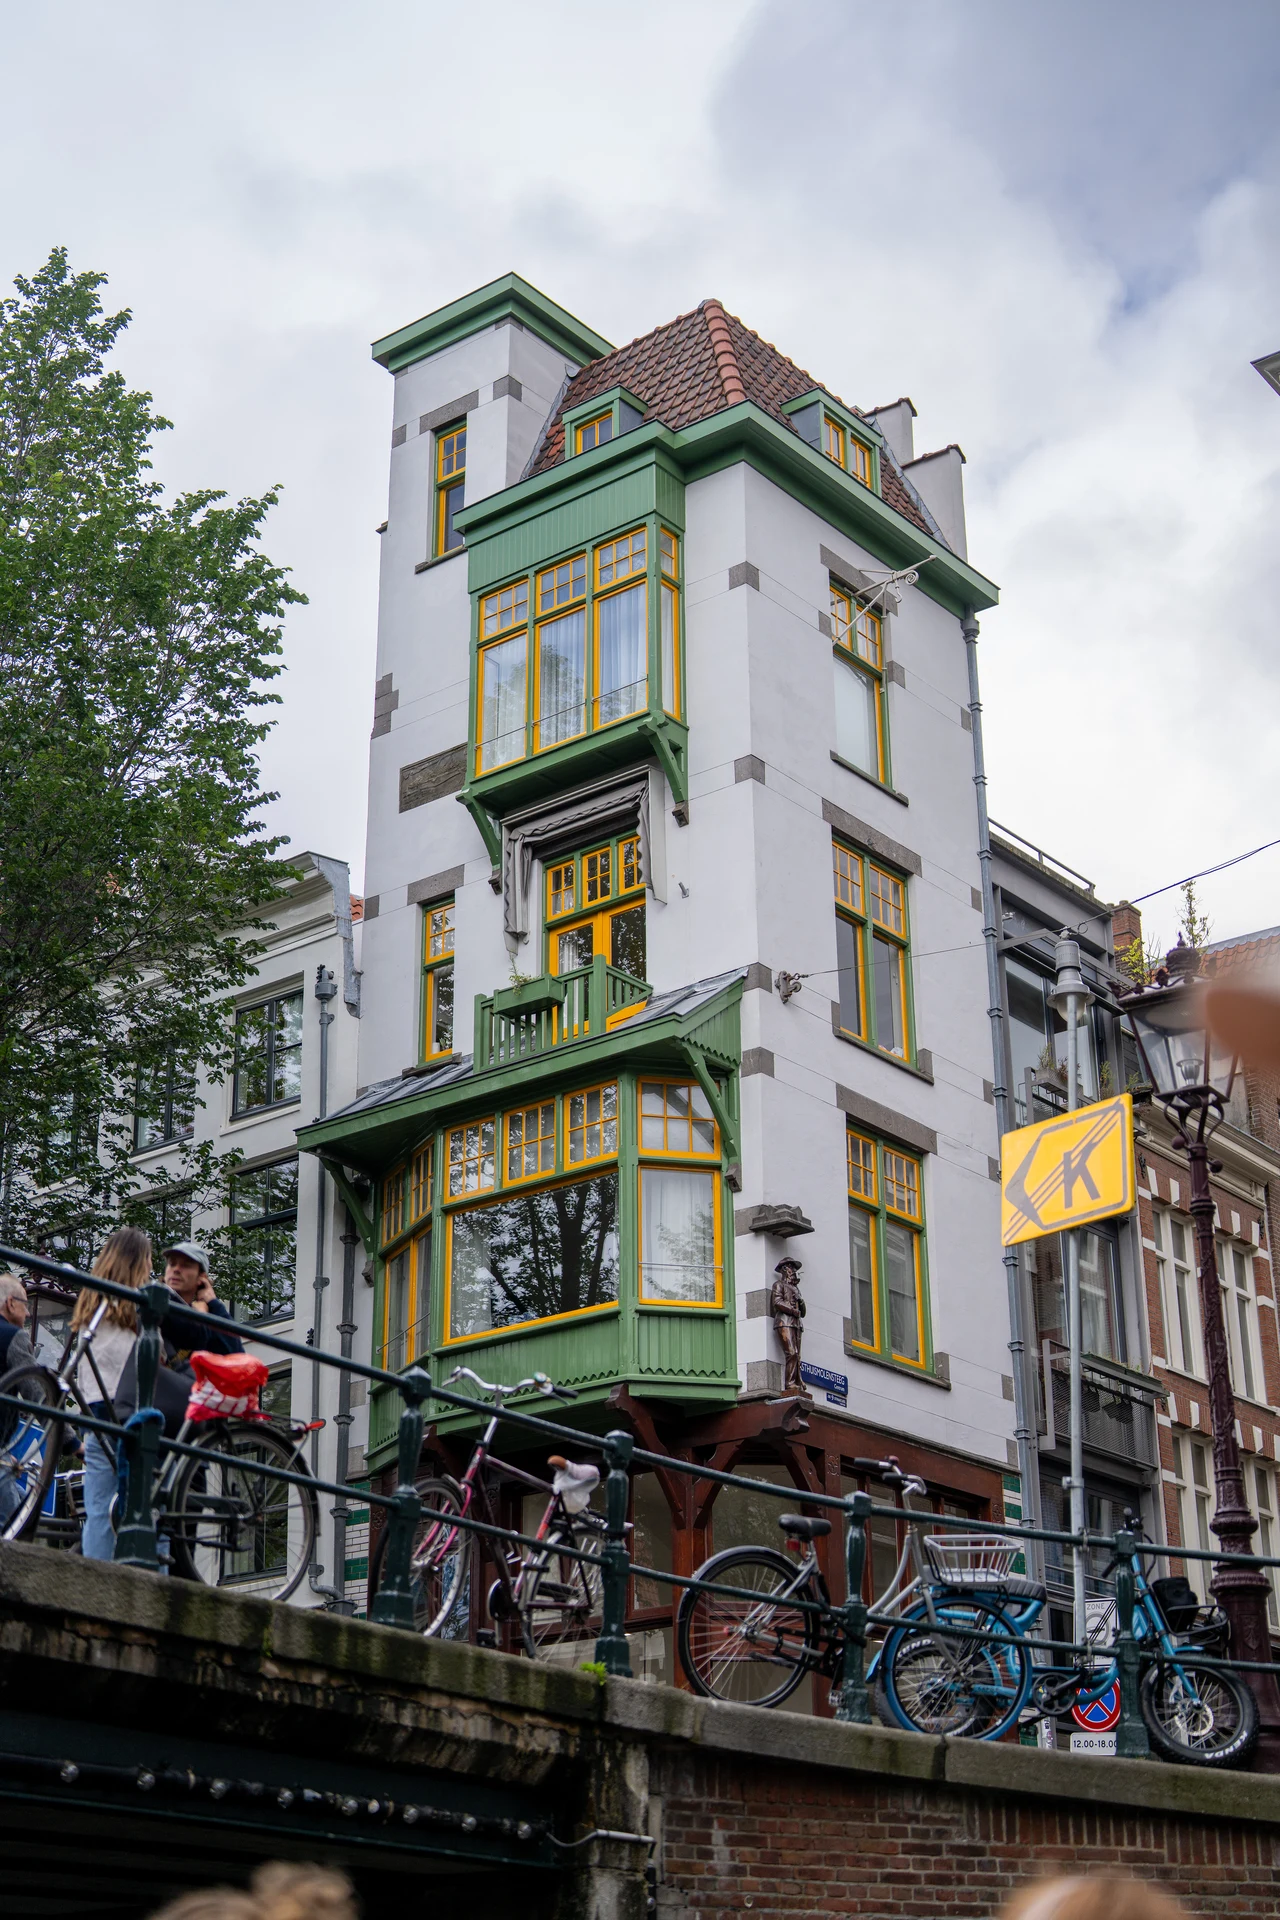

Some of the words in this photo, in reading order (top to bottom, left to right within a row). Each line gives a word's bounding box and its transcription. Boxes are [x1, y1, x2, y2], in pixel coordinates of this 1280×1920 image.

[800, 1362, 845, 1385] STHUISMOLENSTEEG
[896, 1638, 935, 1661] KEND
[1073, 1739, 1117, 1749] 12.00-18.00
[1204, 1730, 1248, 1759] KENDA
